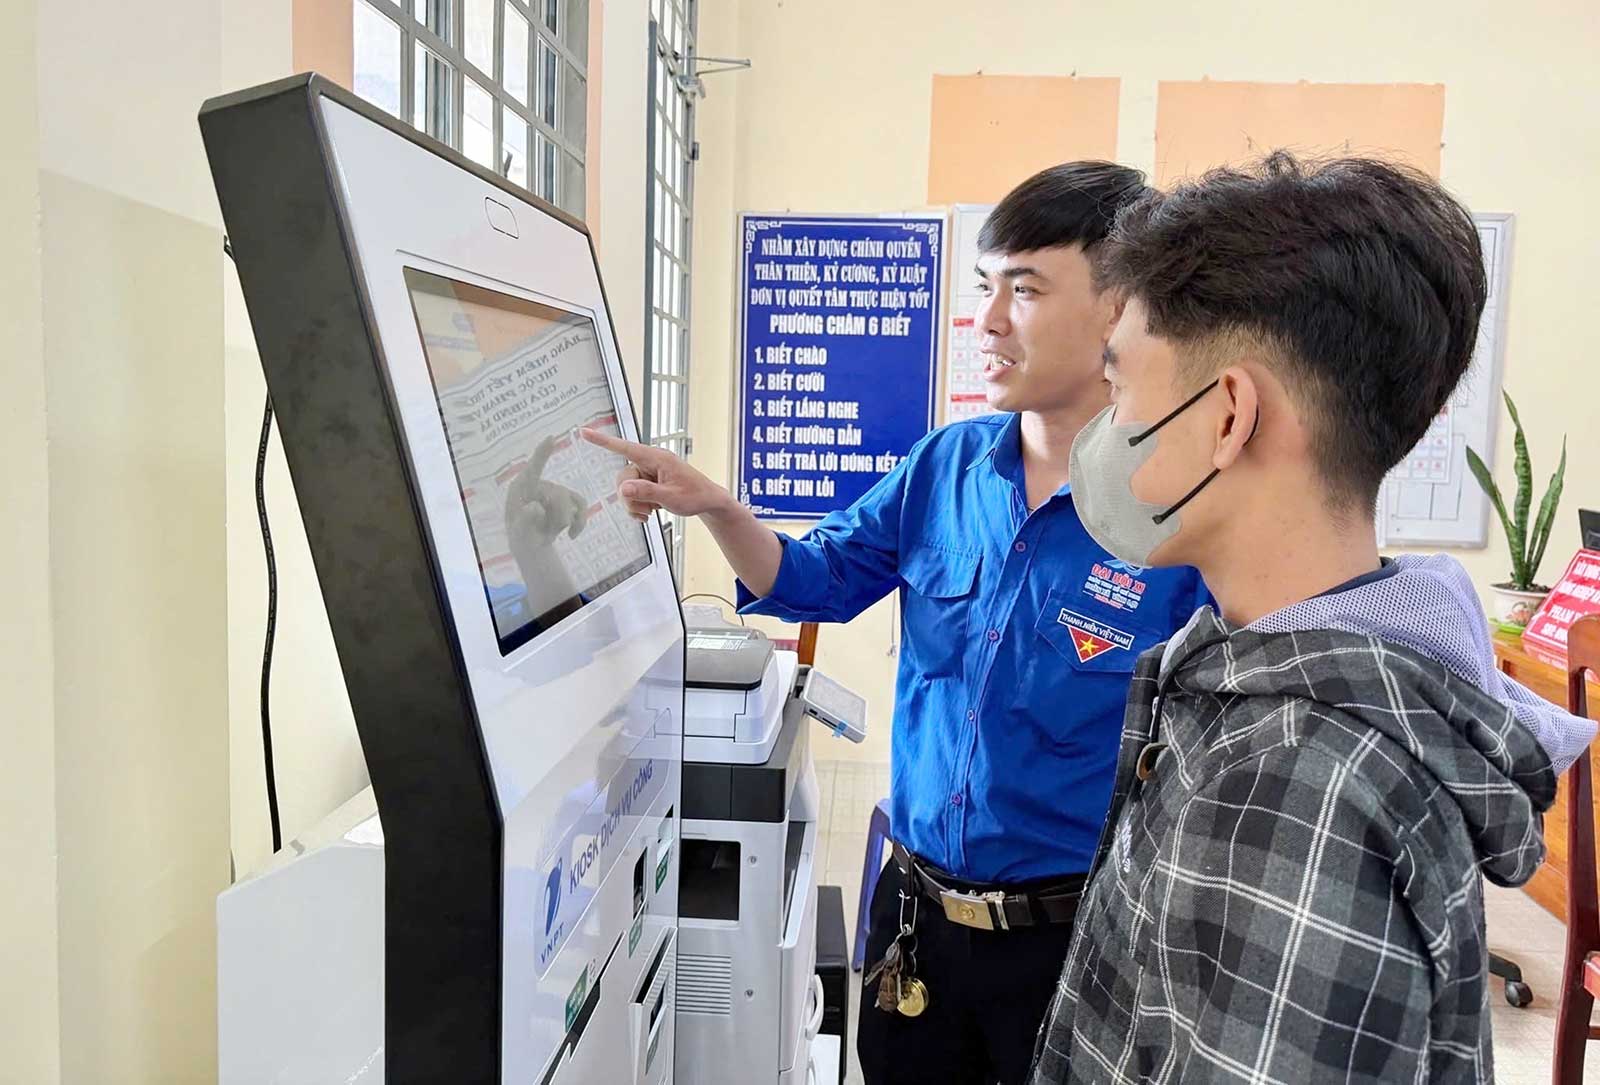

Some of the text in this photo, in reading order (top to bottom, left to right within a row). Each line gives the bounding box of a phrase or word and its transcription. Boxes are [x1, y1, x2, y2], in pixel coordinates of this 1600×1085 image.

[794, 236, 816, 256] XÂY
[818, 239, 848, 259] DỰNG
[850, 237, 884, 257] CHÍNH
[755, 261, 783, 280] THÂN
[785, 261, 821, 284] THIỆN,
[841, 264, 880, 285] CƯƠNG,
[900, 263, 928, 286] LUẬT
[750, 285, 930, 311] ĐƠN VỊ QUYẾT TÂM THỰC HIỆN TỐT
[769, 311, 912, 336] PHƯƠNG CHÂM 6 BIẾT
[754, 342, 827, 366] 1. BIẾT CHÀO
[754, 369, 825, 392] 2. BIẾT CƯỜI
[753, 399, 765, 417] 3.
[767, 395, 793, 418] BIẾT
[828, 401, 859, 419] NGHE
[752, 426, 764, 444] 4.
[766, 422, 792, 444] BIẾT
[837, 423, 862, 445] DẪN
[752, 452, 764, 470] 5.
[765, 448, 792, 470] BIẾT
[794, 450, 818, 470] TRẢ
[820, 452, 838, 472] LỜI
[840, 453, 873, 472] ĐÚNG
[875, 449, 898, 472] KẾT
[752, 474, 835, 497] 6. BIẾT XIN LỖI
[1062, 613, 1084, 627] THANH
[1099, 627, 1114, 641] VIỆT
[1112, 634, 1130, 646] NAM
[569, 832, 599, 894] KIOSK
[600, 803, 620, 849] DỊCH
[633, 759, 653, 800] CÔNG
[541, 921, 564, 963] VNPT
